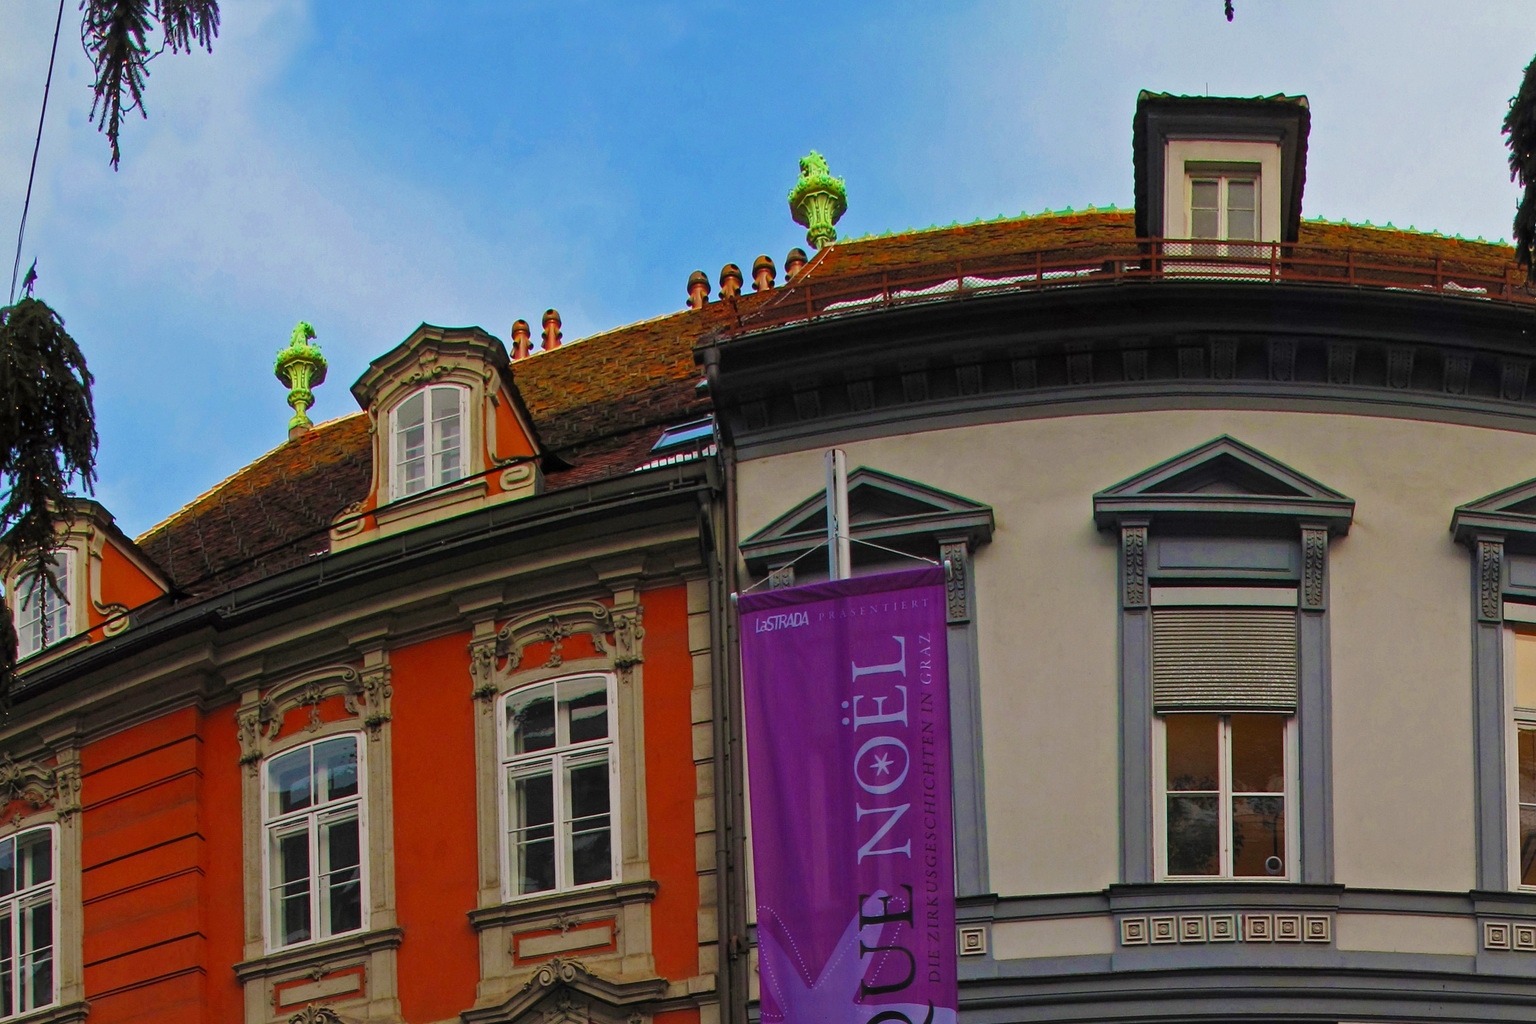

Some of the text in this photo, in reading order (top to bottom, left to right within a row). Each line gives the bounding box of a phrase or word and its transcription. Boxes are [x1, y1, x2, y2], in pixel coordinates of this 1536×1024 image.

[841, 635, 911, 865] NOËL
[918, 632, 941, 983] DIE ZIRKUSGESCHICHTEN IN GRAZ
